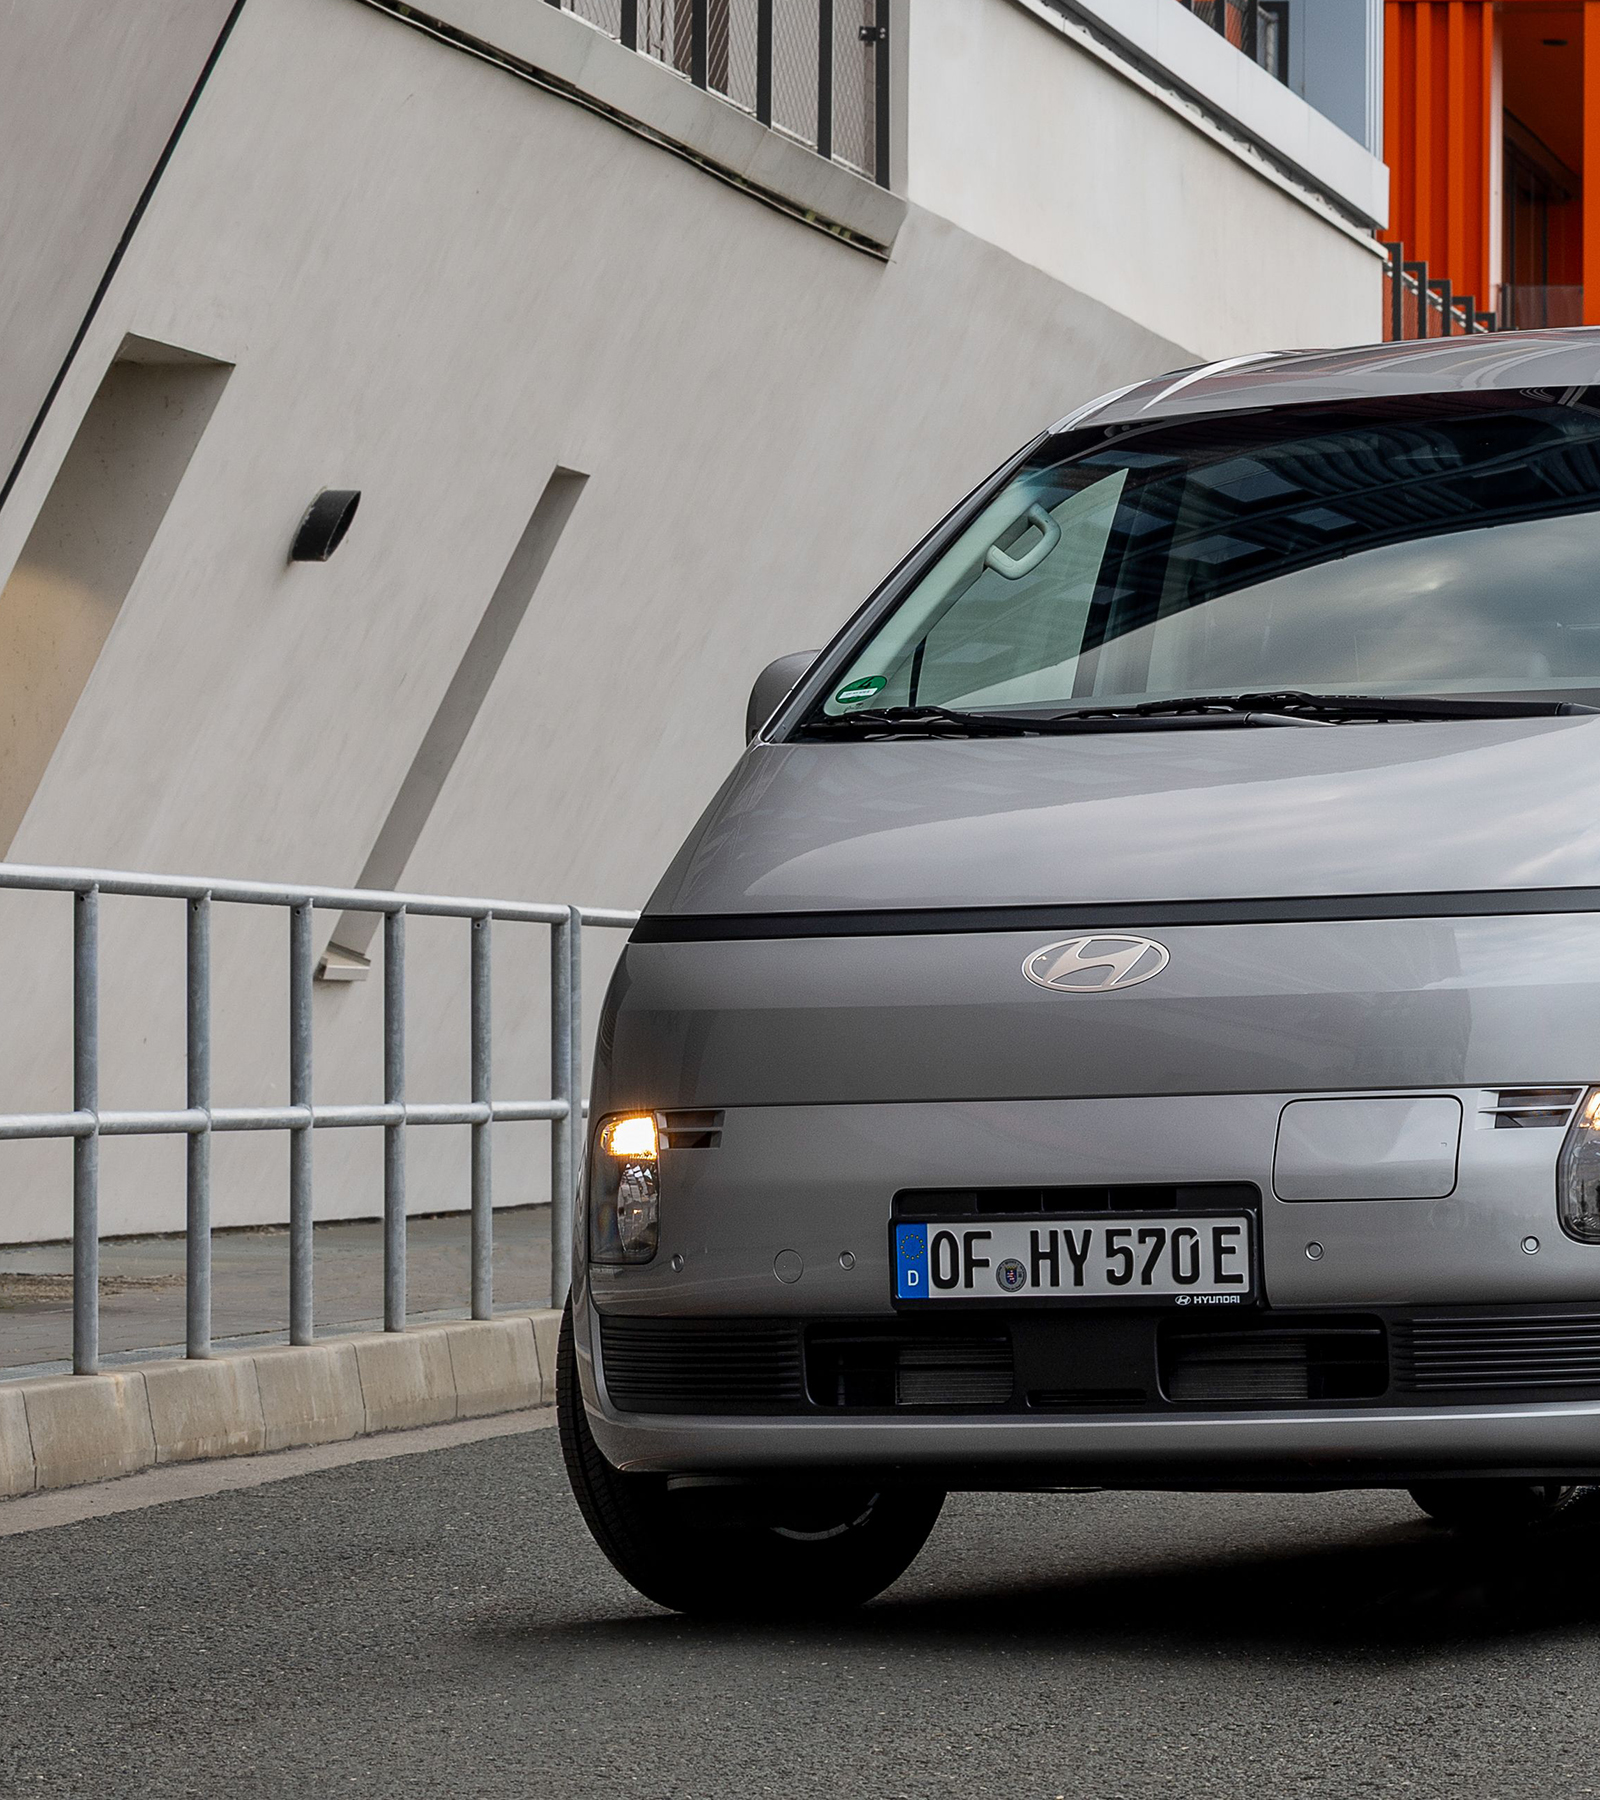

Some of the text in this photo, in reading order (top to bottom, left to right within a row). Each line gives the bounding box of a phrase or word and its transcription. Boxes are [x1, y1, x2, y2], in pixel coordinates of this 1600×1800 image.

[857, 677, 875, 690] 4
[930, 1230, 992, 1290] OF
[1030, 1228, 1093, 1288] HY
[907, 1270, 919, 1287] D
[1193, 1295, 1240, 1304] HYUNDAI
